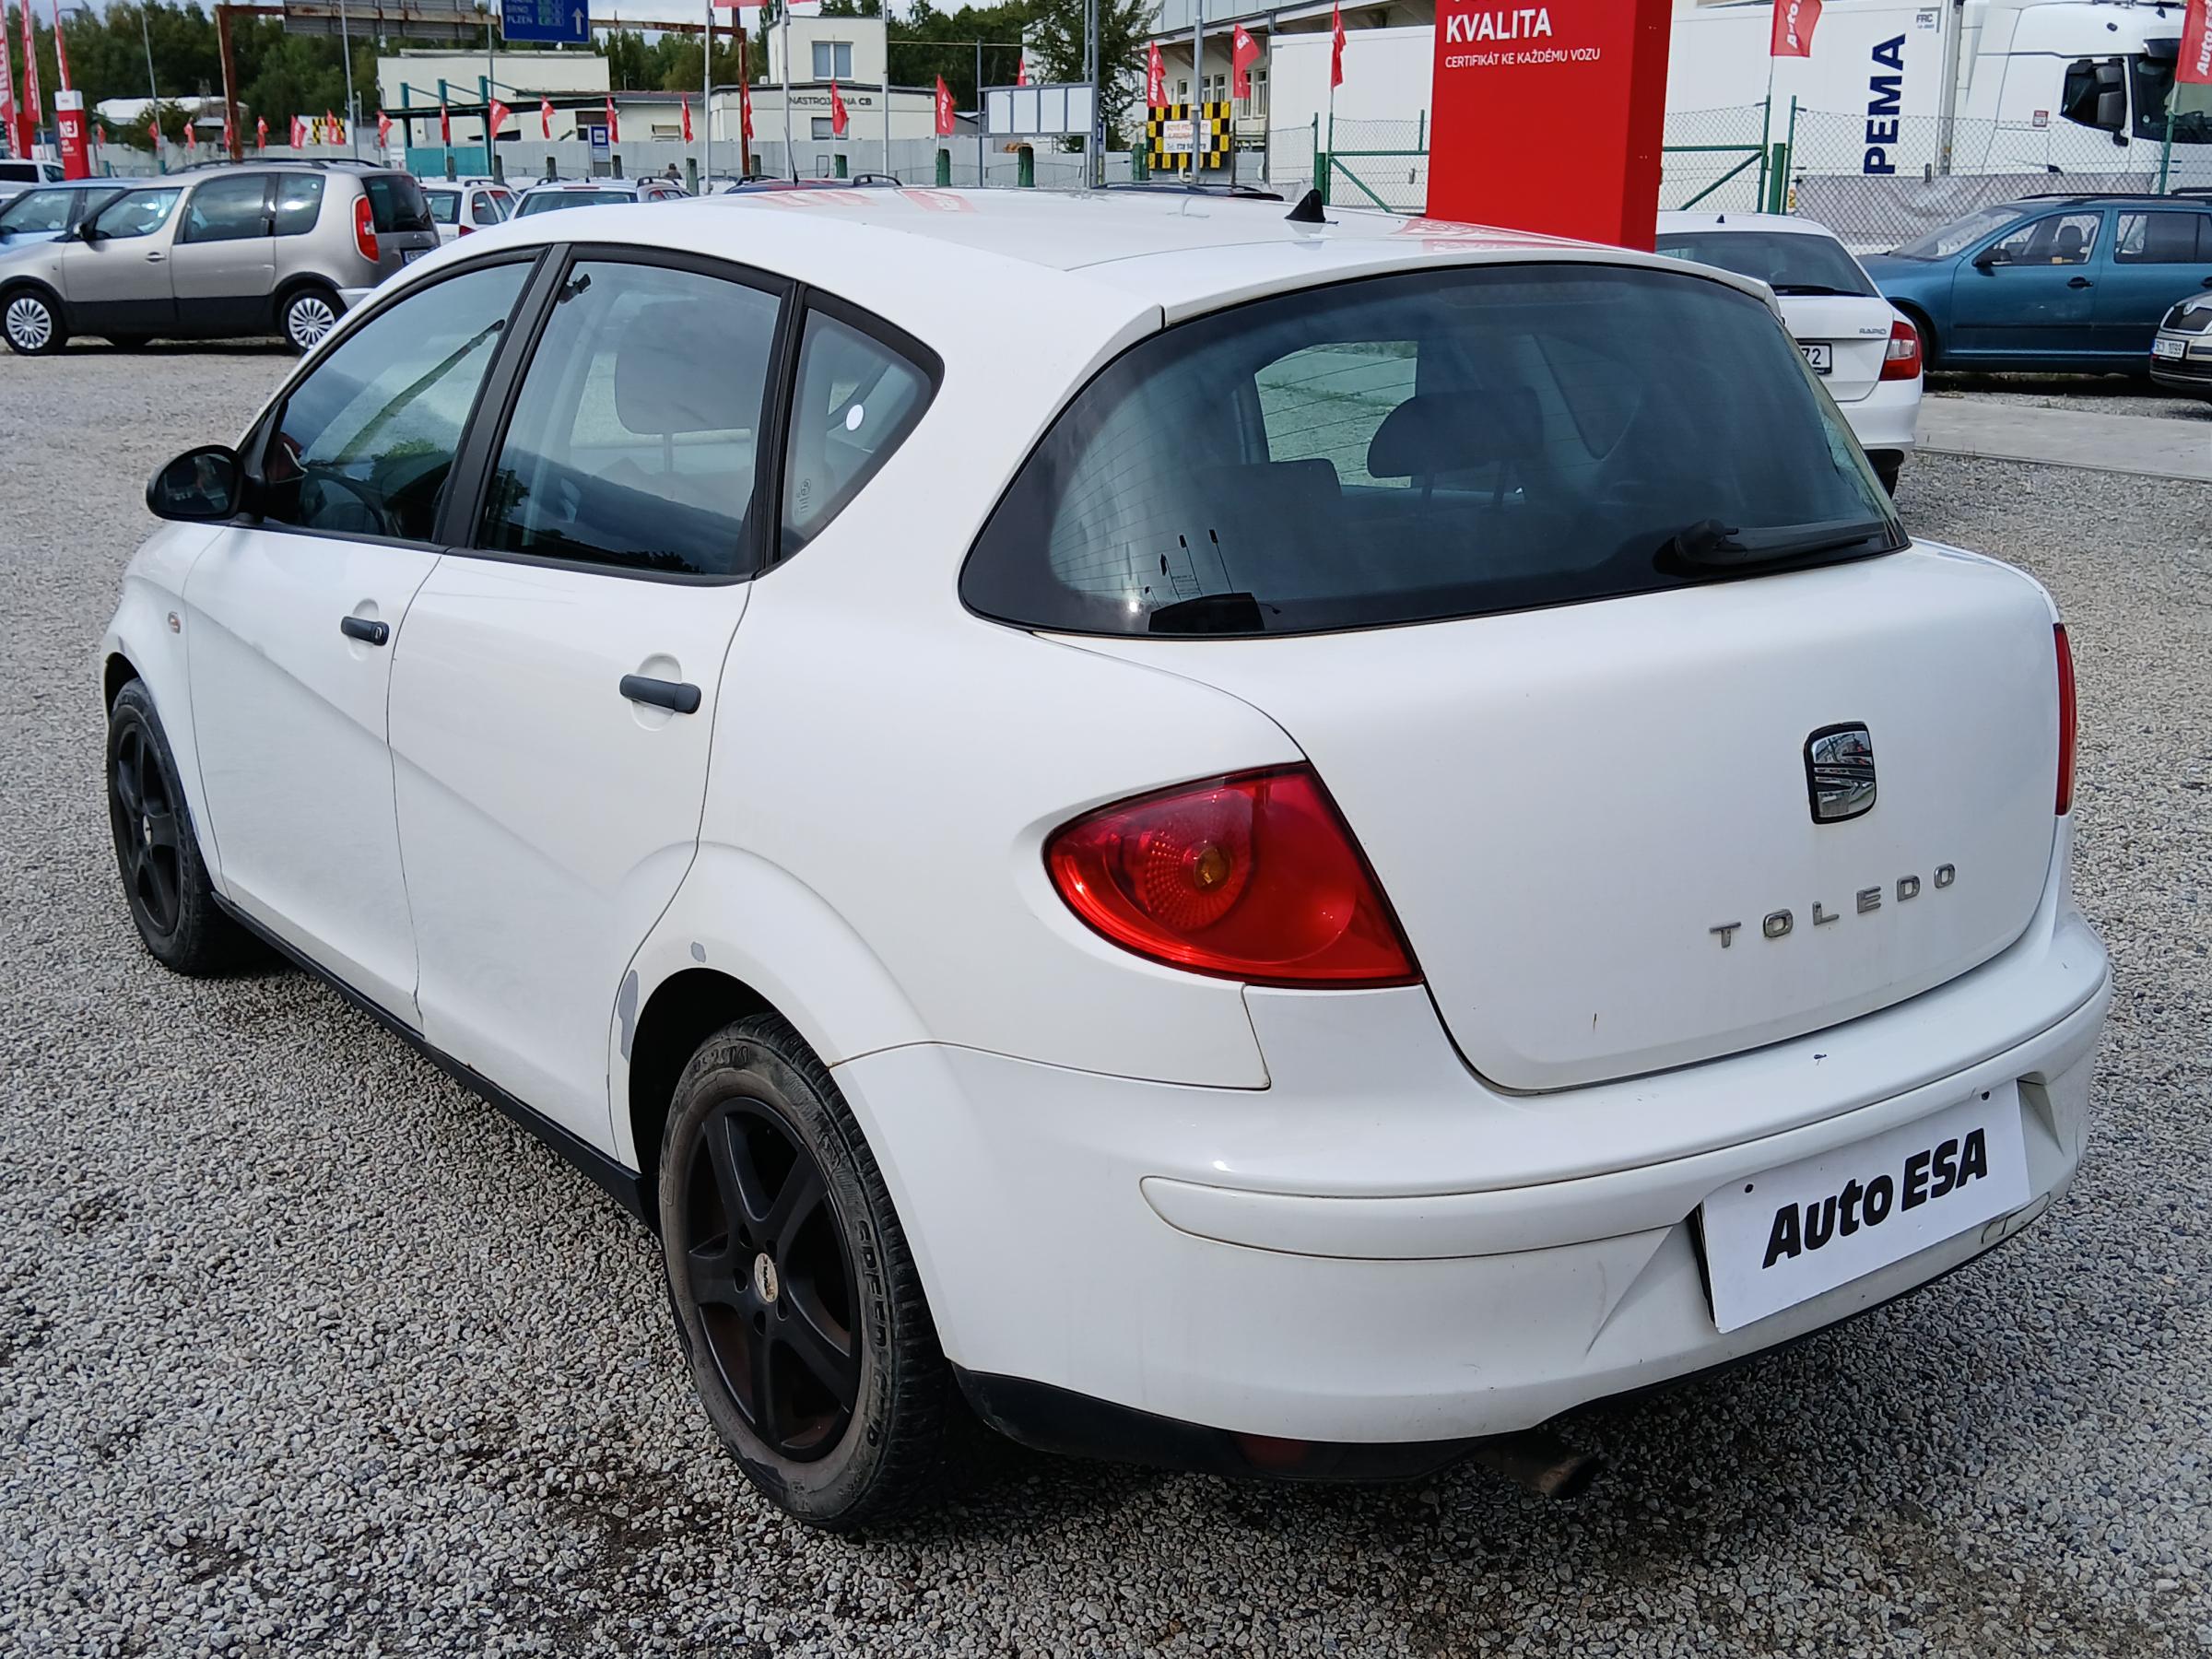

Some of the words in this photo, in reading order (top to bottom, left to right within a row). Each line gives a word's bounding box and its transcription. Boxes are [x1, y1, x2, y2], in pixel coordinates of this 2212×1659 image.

[1445, 7, 1553, 43] KVALITA
[1444, 51, 1500, 68] CERTIFIKÁT
[1501, 53, 1514, 65] KE
[1517, 48, 1569, 64] KAŽDÉMU
[1571, 47, 1601, 62] VOZU
[789, 96, 857, 106] NASTROJNA
[858, 98, 872, 106] CB
[1863, 33, 1906, 174] PEMA
[1709, 863, 1956, 949] TOLEDO
[1762, 1174, 1893, 1270] Auto
[1901, 1127, 1988, 1213] ESA
